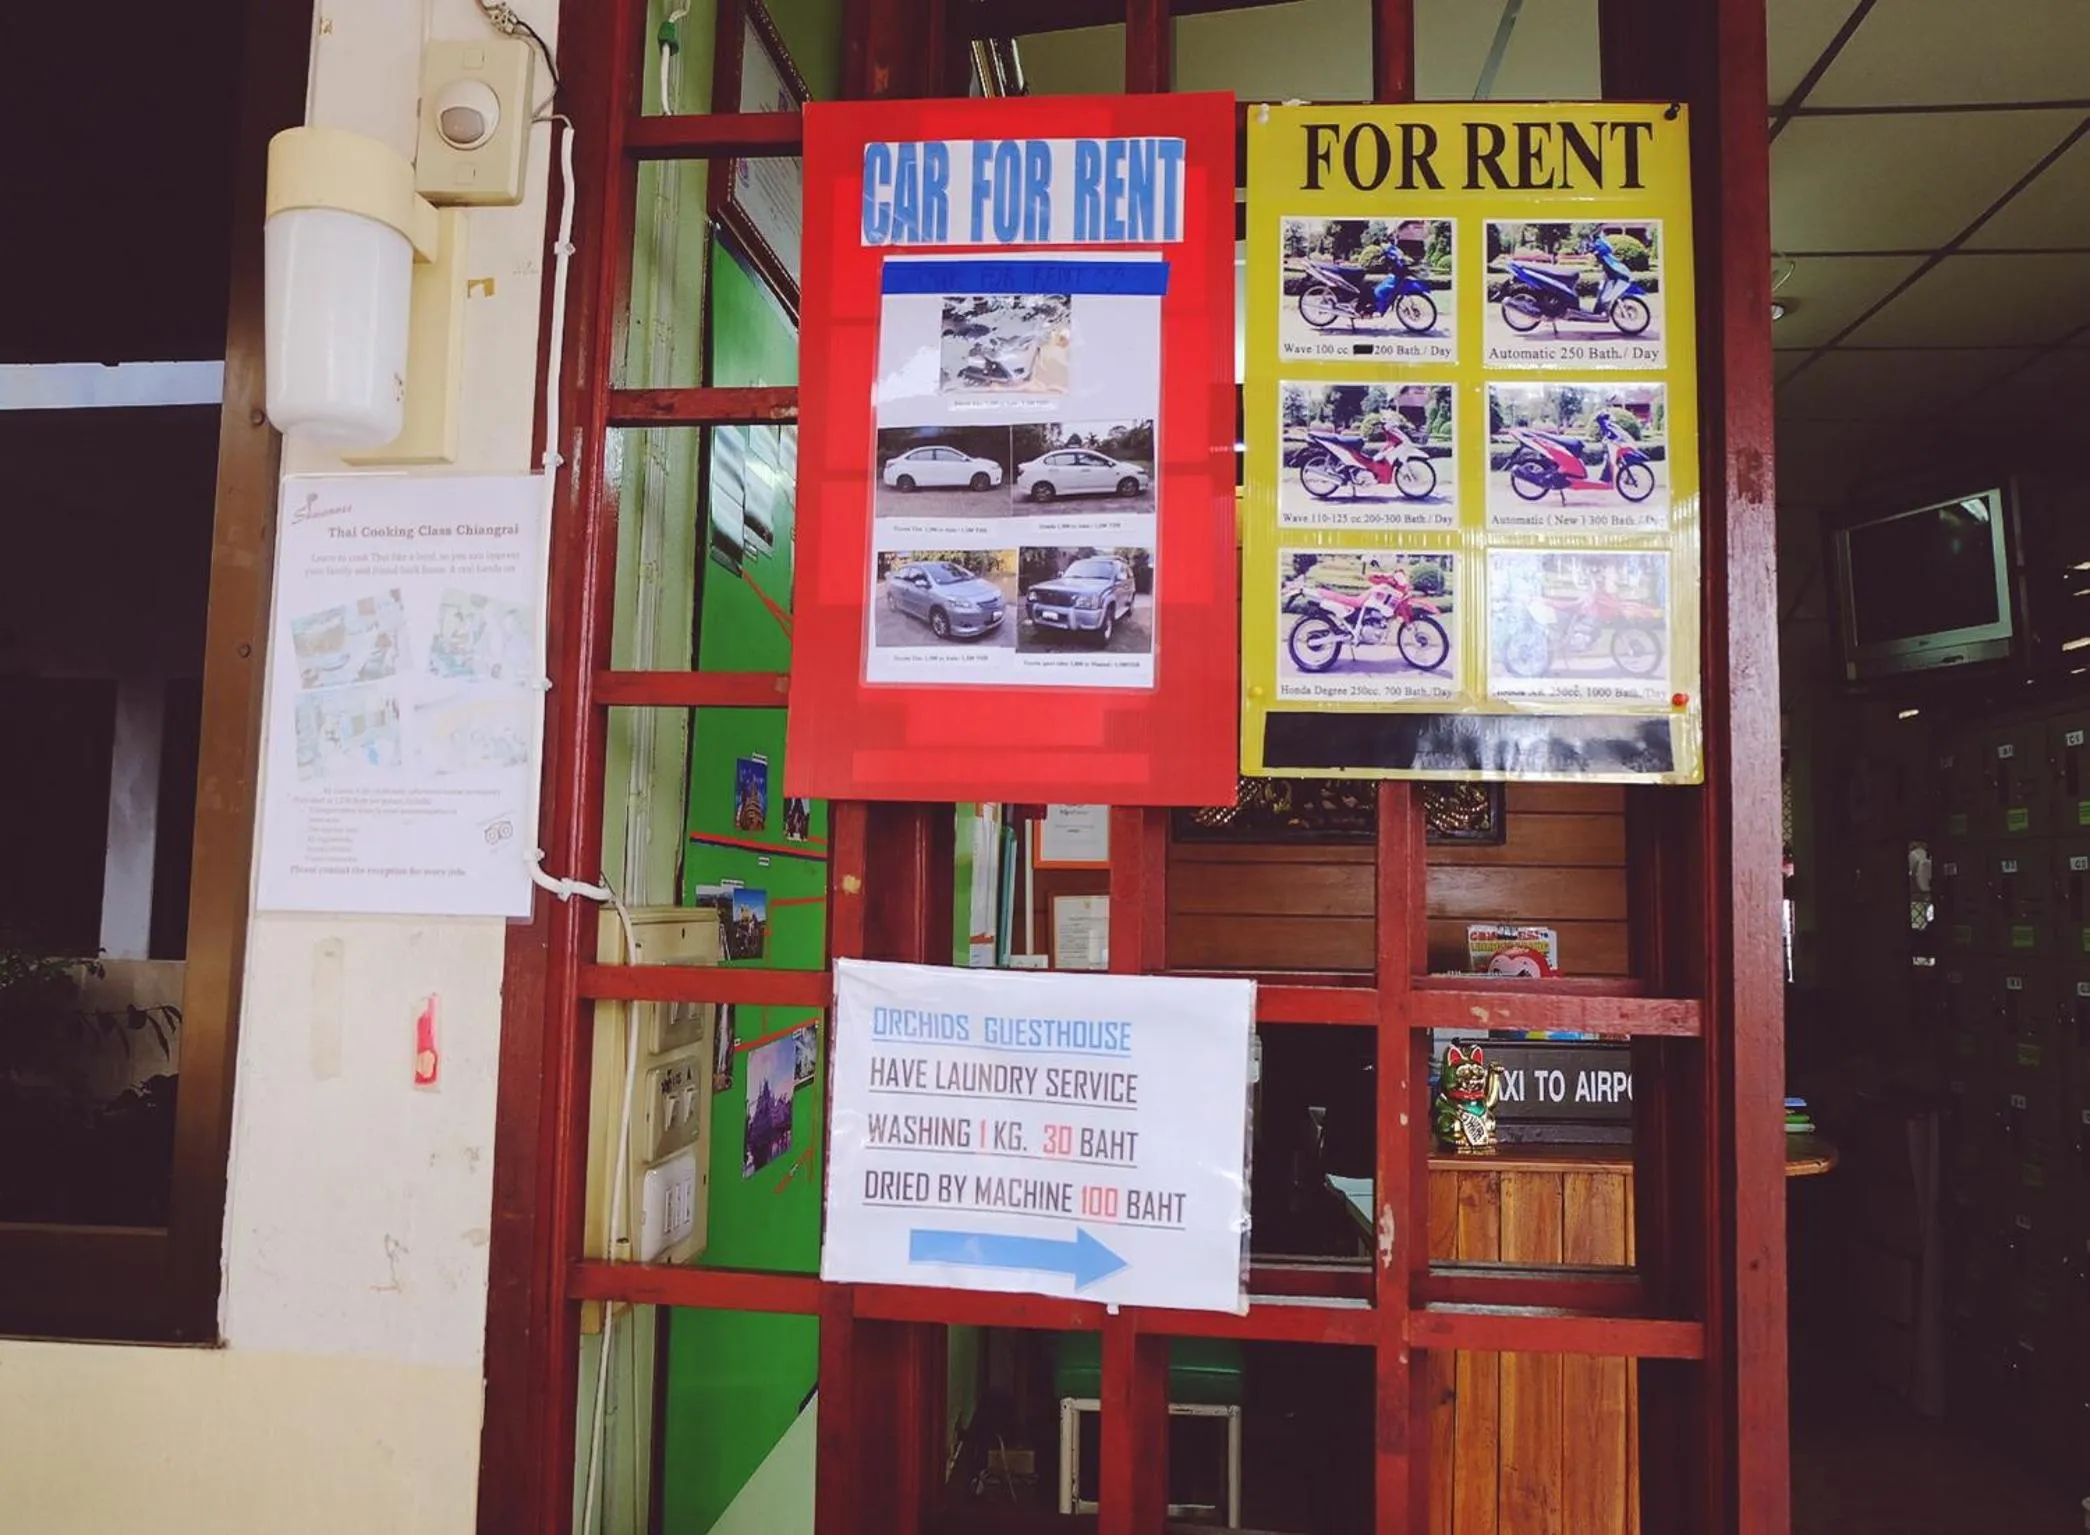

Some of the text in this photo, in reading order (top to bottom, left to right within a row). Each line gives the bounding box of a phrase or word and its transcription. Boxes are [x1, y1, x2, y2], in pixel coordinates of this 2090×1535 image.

[1301, 122, 1653, 191] FOR RENT
[863, 142, 950, 244] CAR
[970, 140, 1053, 243] FOR
[1073, 138, 1185, 242] RENT
[1283, 343, 1313, 354] Wave
[1316, 344, 1335, 355] 100
[1374, 344, 1393, 356] 200
[1430, 345, 1452, 359] Day
[1489, 346, 1556, 360] Automatic
[1560, 346, 1584, 360] 250
[1632, 347, 1660, 362] Day
[1282, 513, 1308, 523] Wave
[1491, 514, 1544, 526] Automatic
[1554, 514, 1577, 526] New
[328, 524, 520, 540] Thai Cooking Class Chiangrai
[1280, 684, 1312, 696] Honda
[1314, 685, 1348, 697] Degree
[1586, 687, 1611, 698] 1000
[872, 1006, 1133, 1051] ORCHIDS GUESTHOUSE
[870, 1057, 1139, 1103] HAVE LAUNDRY SERVICE
[1534, 1070, 1566, 1102] TO
[867, 1113, 1139, 1162] WASHING 1 KG. 30 BAHT
[864, 1170, 1187, 1224] DRIED BY MACHINE 100 BAHT
